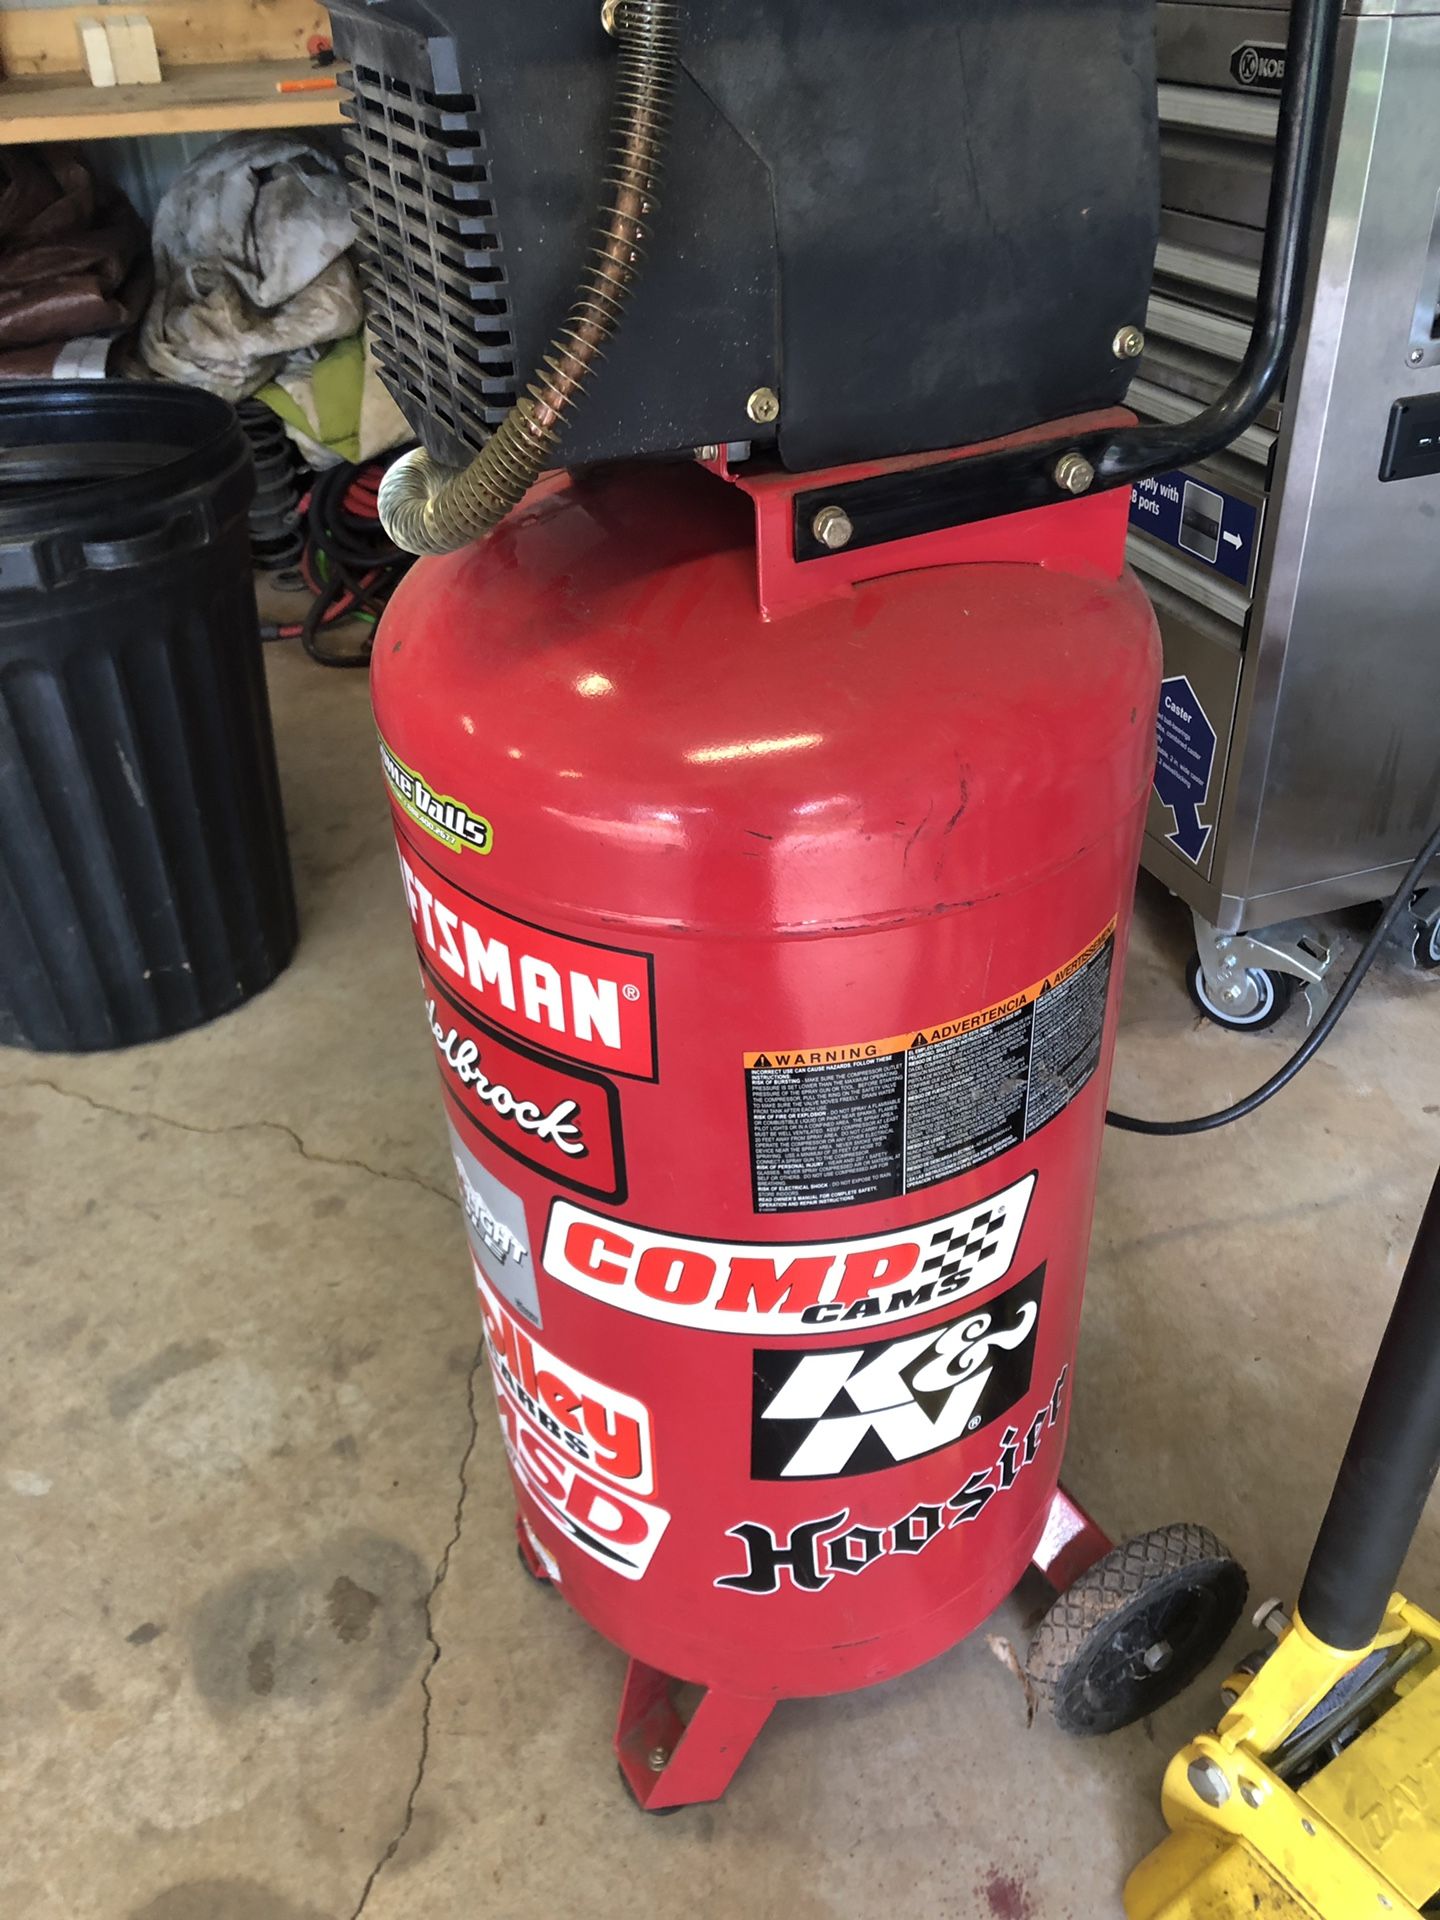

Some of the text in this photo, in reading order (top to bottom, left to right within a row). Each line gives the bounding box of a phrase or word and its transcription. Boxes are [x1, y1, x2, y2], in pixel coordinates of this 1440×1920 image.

[1137, 477, 1179, 503] pply with
[1138, 495, 1160, 516] ports
[1165, 695, 1193, 724] Caster
[399, 850, 621, 1049] FTSMAN
[931, 995, 1027, 1042] ADVERTENCIA
[775, 1045, 877, 1066] WARNING
[853, 1058, 875, 1067] FOLLOW
[876, 1055, 892, 1063] THESE
[831, 1190, 857, 1198] COMPLETE
[564, 1221, 921, 1314] COMP
[800, 1267, 972, 1325] CAMS
[760, 1300, 1038, 1477] K&N
